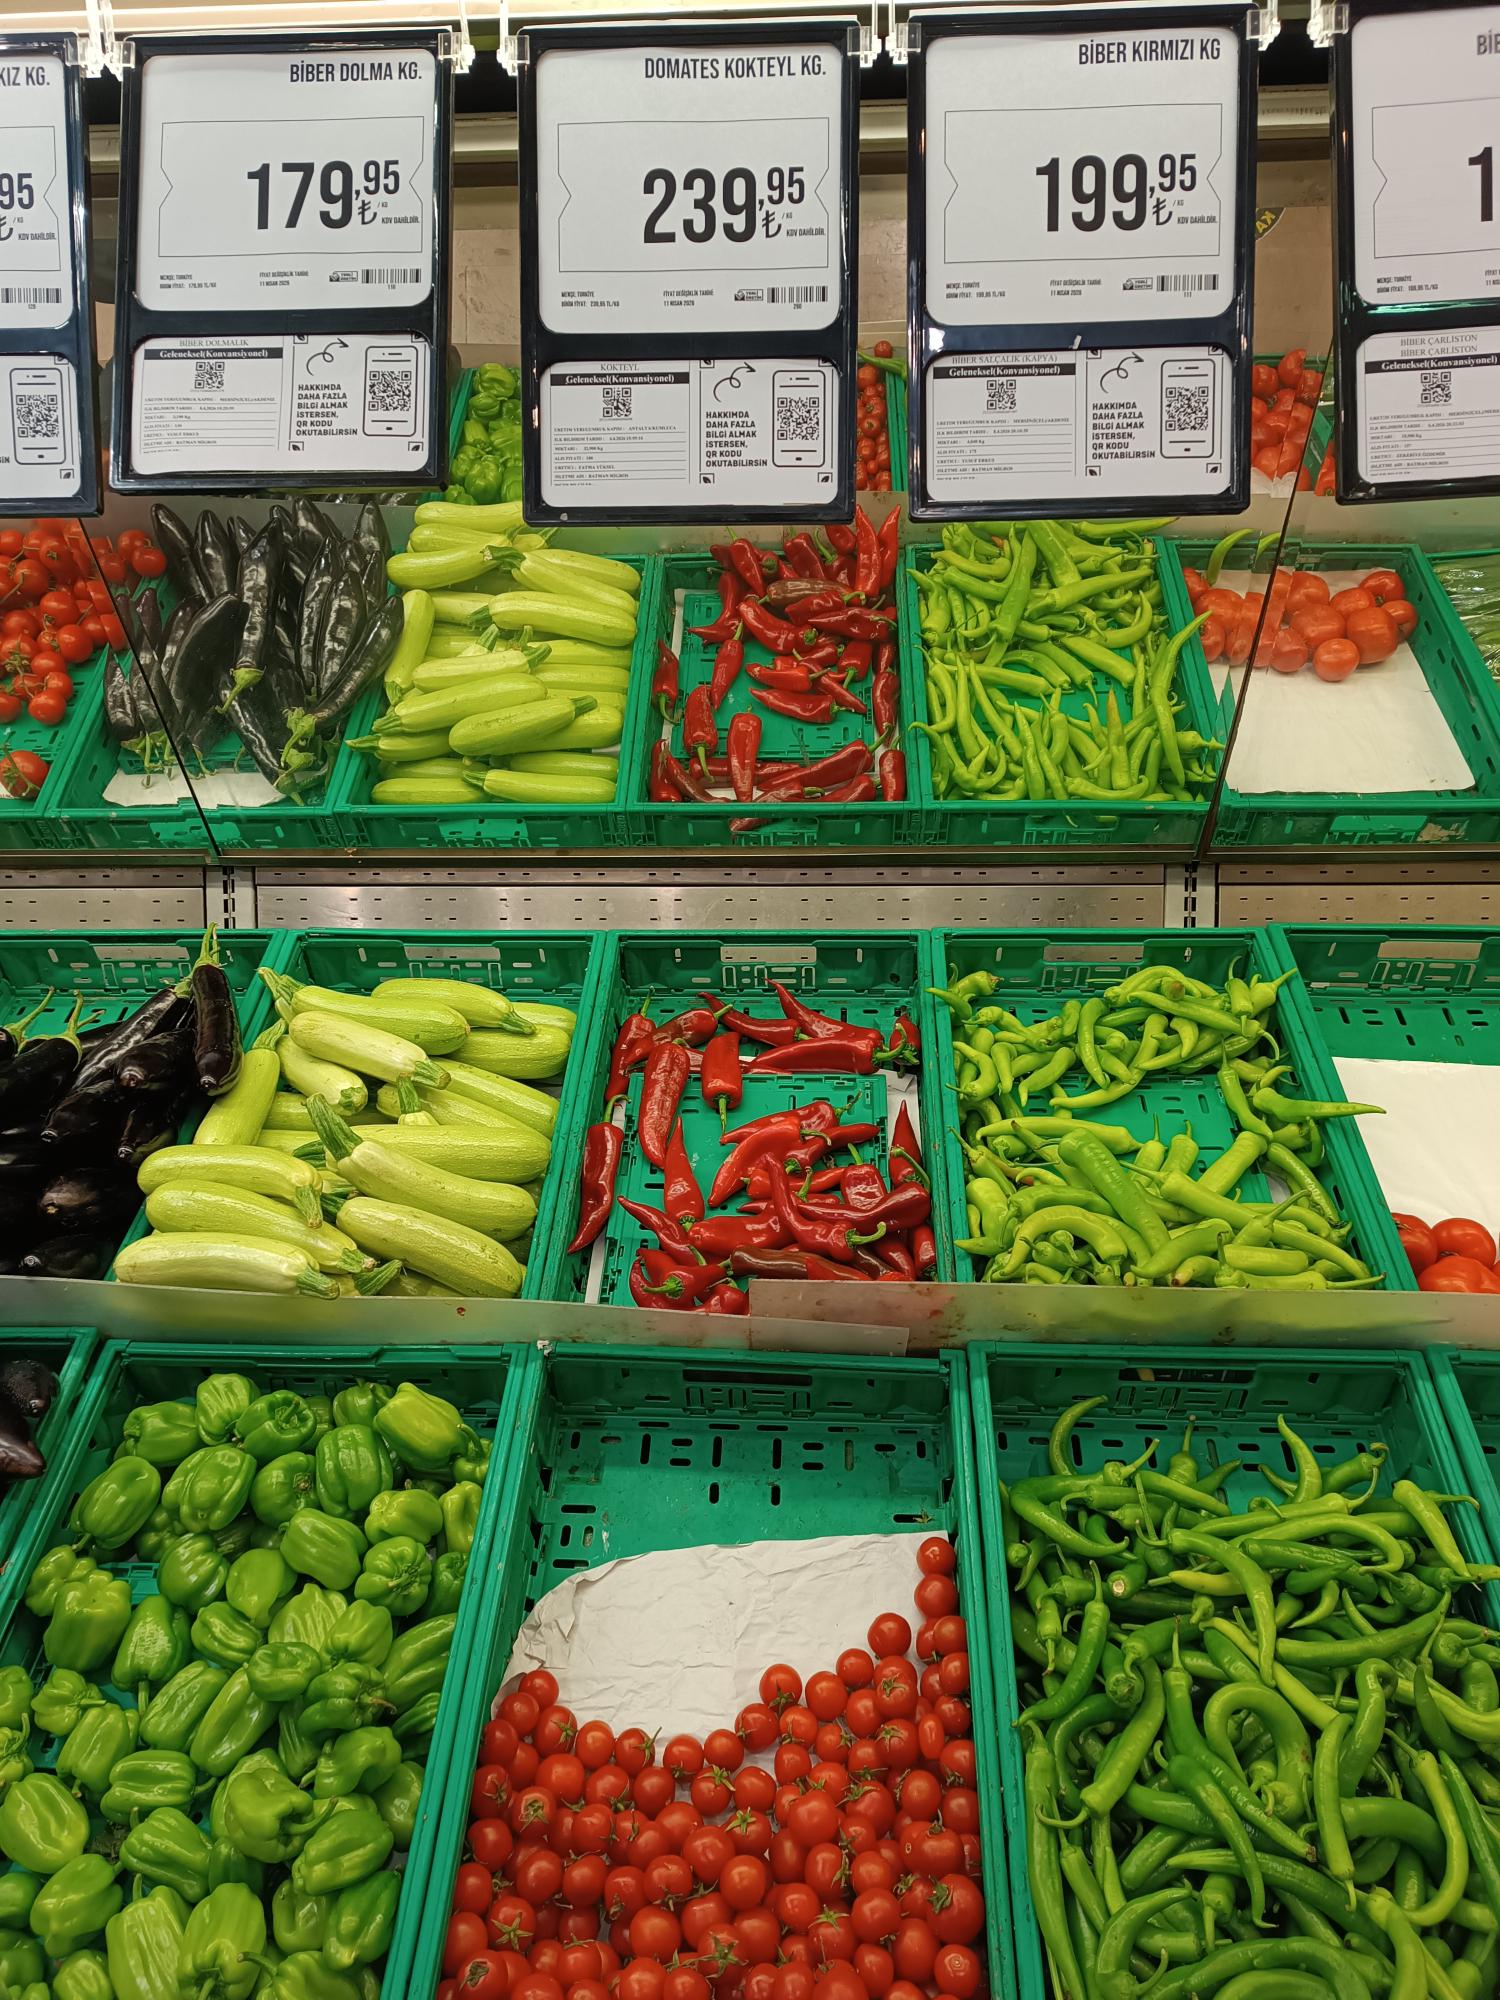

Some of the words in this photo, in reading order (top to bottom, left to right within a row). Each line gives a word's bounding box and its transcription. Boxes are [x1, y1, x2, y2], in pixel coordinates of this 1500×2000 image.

[1078, 39, 1126, 65] BİBER
[1132, 39, 1194, 62] KIRMIZI
[1200, 38, 1220, 60] KG
[290, 60, 334, 82] BİBER
[340, 62, 392, 82] DOLMA
[398, 62, 422, 80] KG.
[644, 57, 720, 79] DOMATES
[724, 56, 796, 78] KOKTEYL
[801, 54, 826, 76] KG.
[26, 66, 50, 86] KG.
[1177, 216, 1189, 225] KDV
[1190, 215, 1218, 224] DAHİLDİR.
[786, 228, 798, 237] KDV
[205, 339, 248, 347] DOLMALIK
[160, 349, 268, 359] Geleneksel(Konvansiyonel)
[979, 355, 1021, 364] SALÇALIK
[1022, 354, 1058, 363] (KAPYA)
[1381, 355, 1498, 370] Geleneksel(Konvansiyonel)
[600, 363, 640, 372] KOKTEYL
[949, 366, 1060, 377] Geleneksel(Konvansiyonel)
[565, 374, 674, 384] Geleneksel(Konvansiyonel)
[322, 392, 347, 400] FAZLA
[320, 401, 348, 409] ALMAK
[1092, 401, 1137, 410] HAKKIMDA
[706, 411, 750, 419] HAKKIMDA
[1092, 412, 1115, 420] DAHA
[1118, 411, 1143, 419] FAZLA
[296, 420, 308, 428] QR
[730, 420, 756, 428] FAZLA
[1092, 422, 1113, 430] BİLGİ
[1115, 421, 1144, 430] ALMAK
[296, 428, 358, 436] OKUTABİLİRSİN
[706, 430, 726, 438] BİLGİ
[729, 430, 757, 438] ALMAK
[1092, 432, 1135, 440] İSTERSEN,
[706, 440, 748, 448] İSTERSEN,
[1092, 442, 1104, 451] QR
[1106, 442, 1129, 450] KODU
[706, 450, 717, 459] QR
[1092, 450, 1155, 460] OKUTABİLİRSİN
[705, 459, 768, 467] OKUTABİLİRSİN
